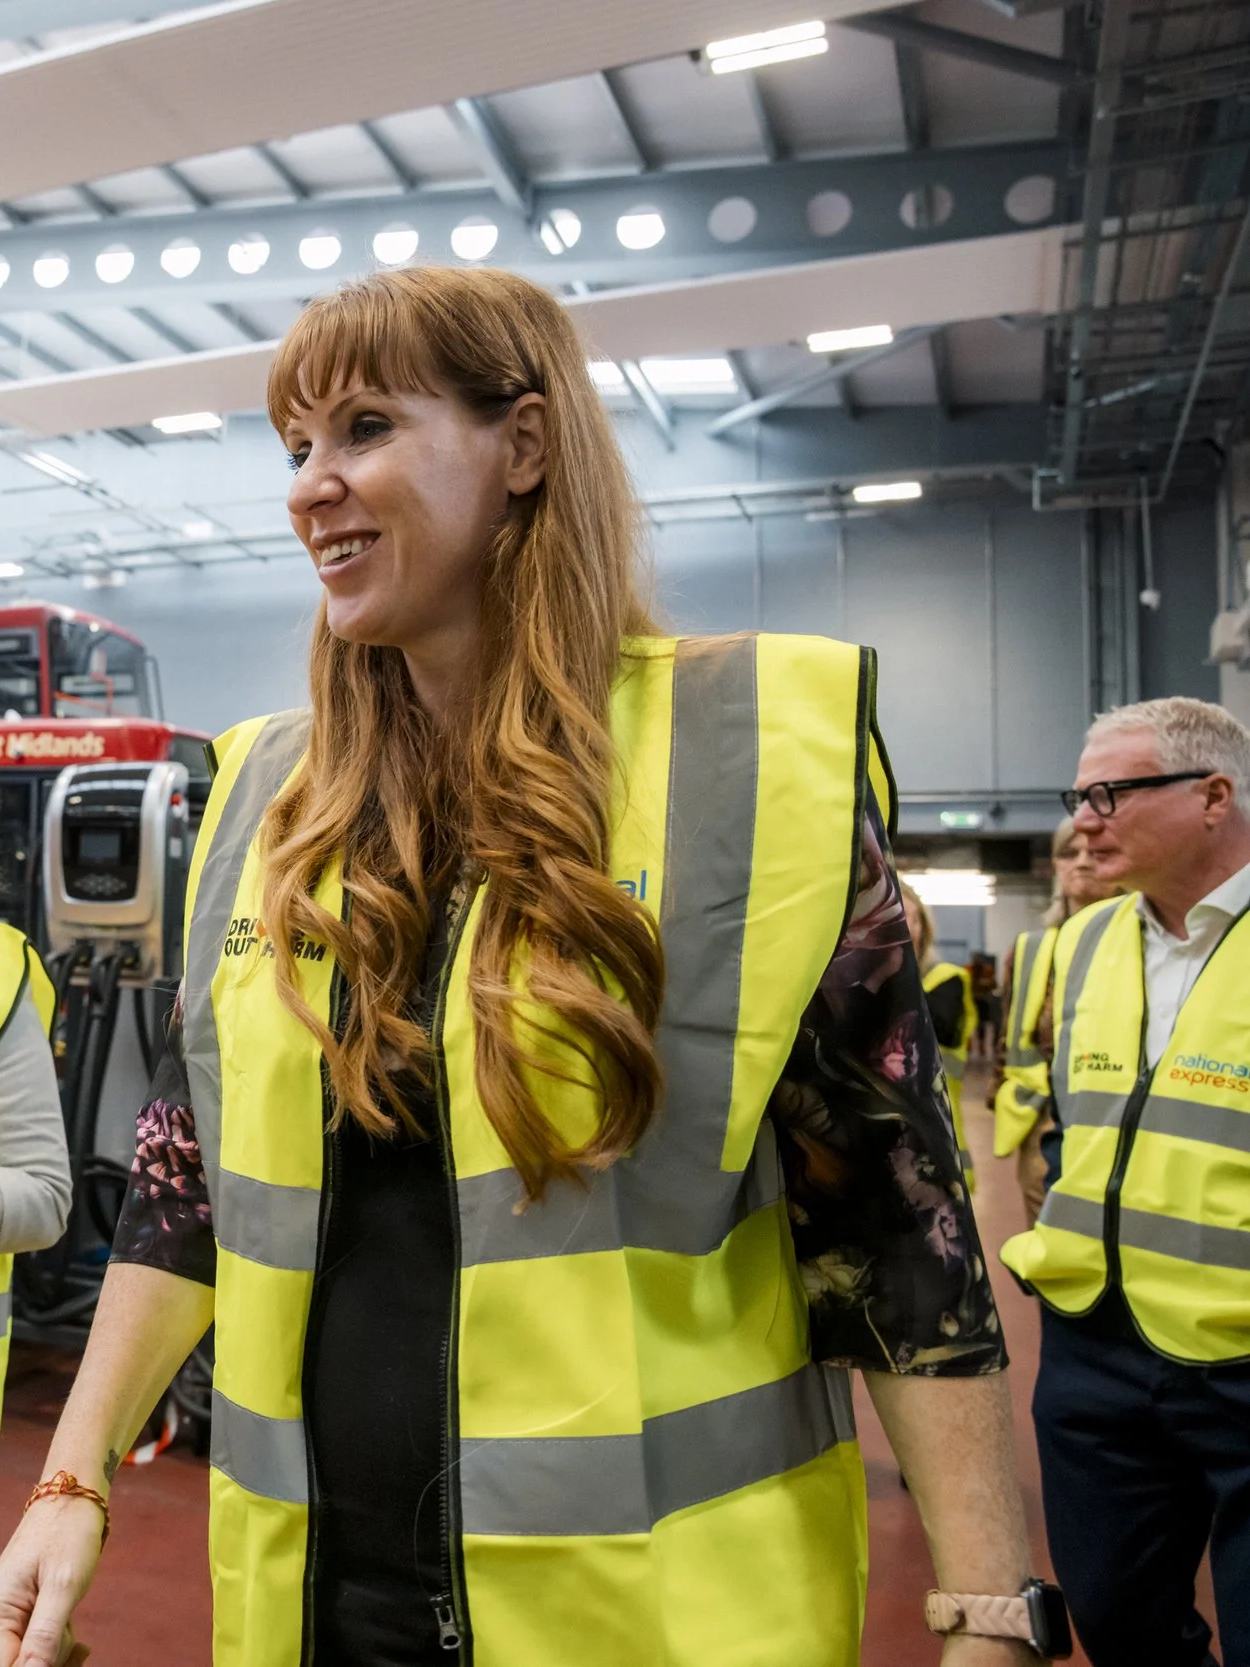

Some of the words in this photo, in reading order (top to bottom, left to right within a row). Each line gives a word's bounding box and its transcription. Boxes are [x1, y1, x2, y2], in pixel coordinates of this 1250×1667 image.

[6, 731, 105, 759] Midlands
[224, 937, 258, 957] OUT
[1170, 1068, 1249, 1093] express
